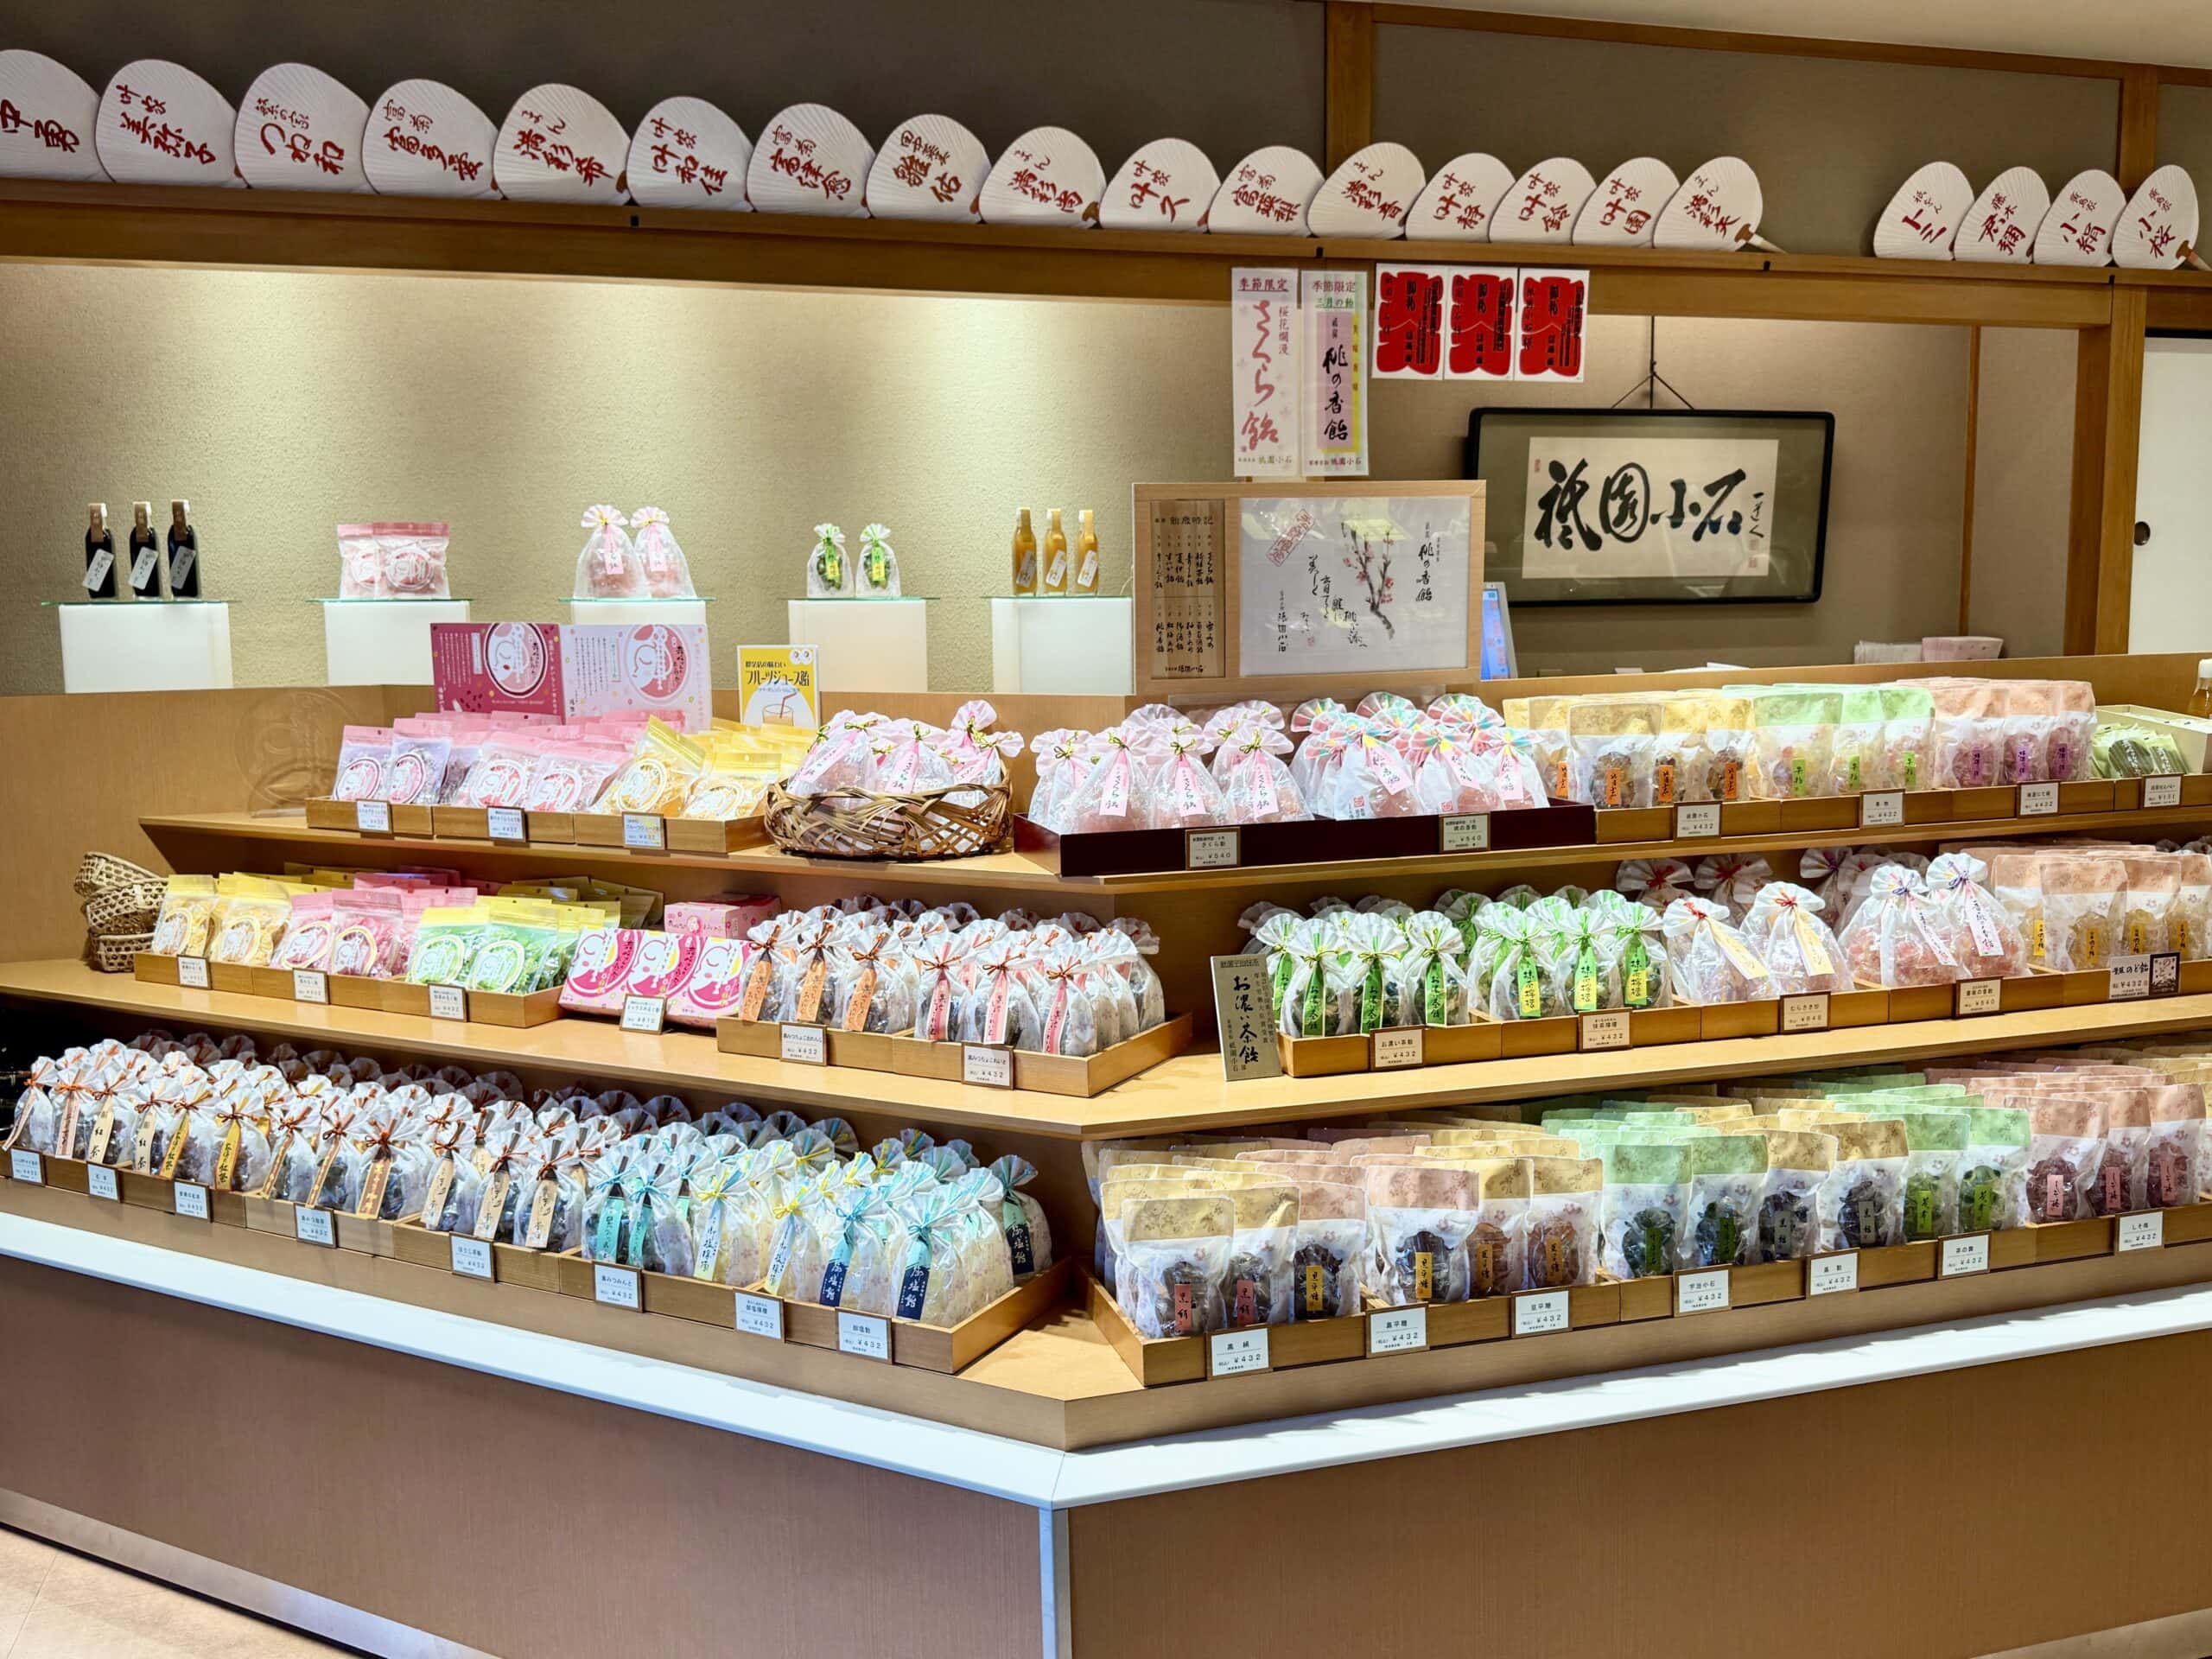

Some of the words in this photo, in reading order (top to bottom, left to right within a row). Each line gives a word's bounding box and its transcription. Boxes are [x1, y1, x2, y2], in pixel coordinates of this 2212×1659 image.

[1238, 278, 1287, 291] 季節限定
[1313, 280, 1356, 293] 季節限定
[1322, 344, 1349, 441] 桃の香飴
[1233, 976, 1259, 1064] お濃い茶飴
[1536, 1313, 1562, 1323] ¥432
[1392, 1332, 1419, 1342] ¥432
[1234, 1353, 1262, 1363] ¥432
